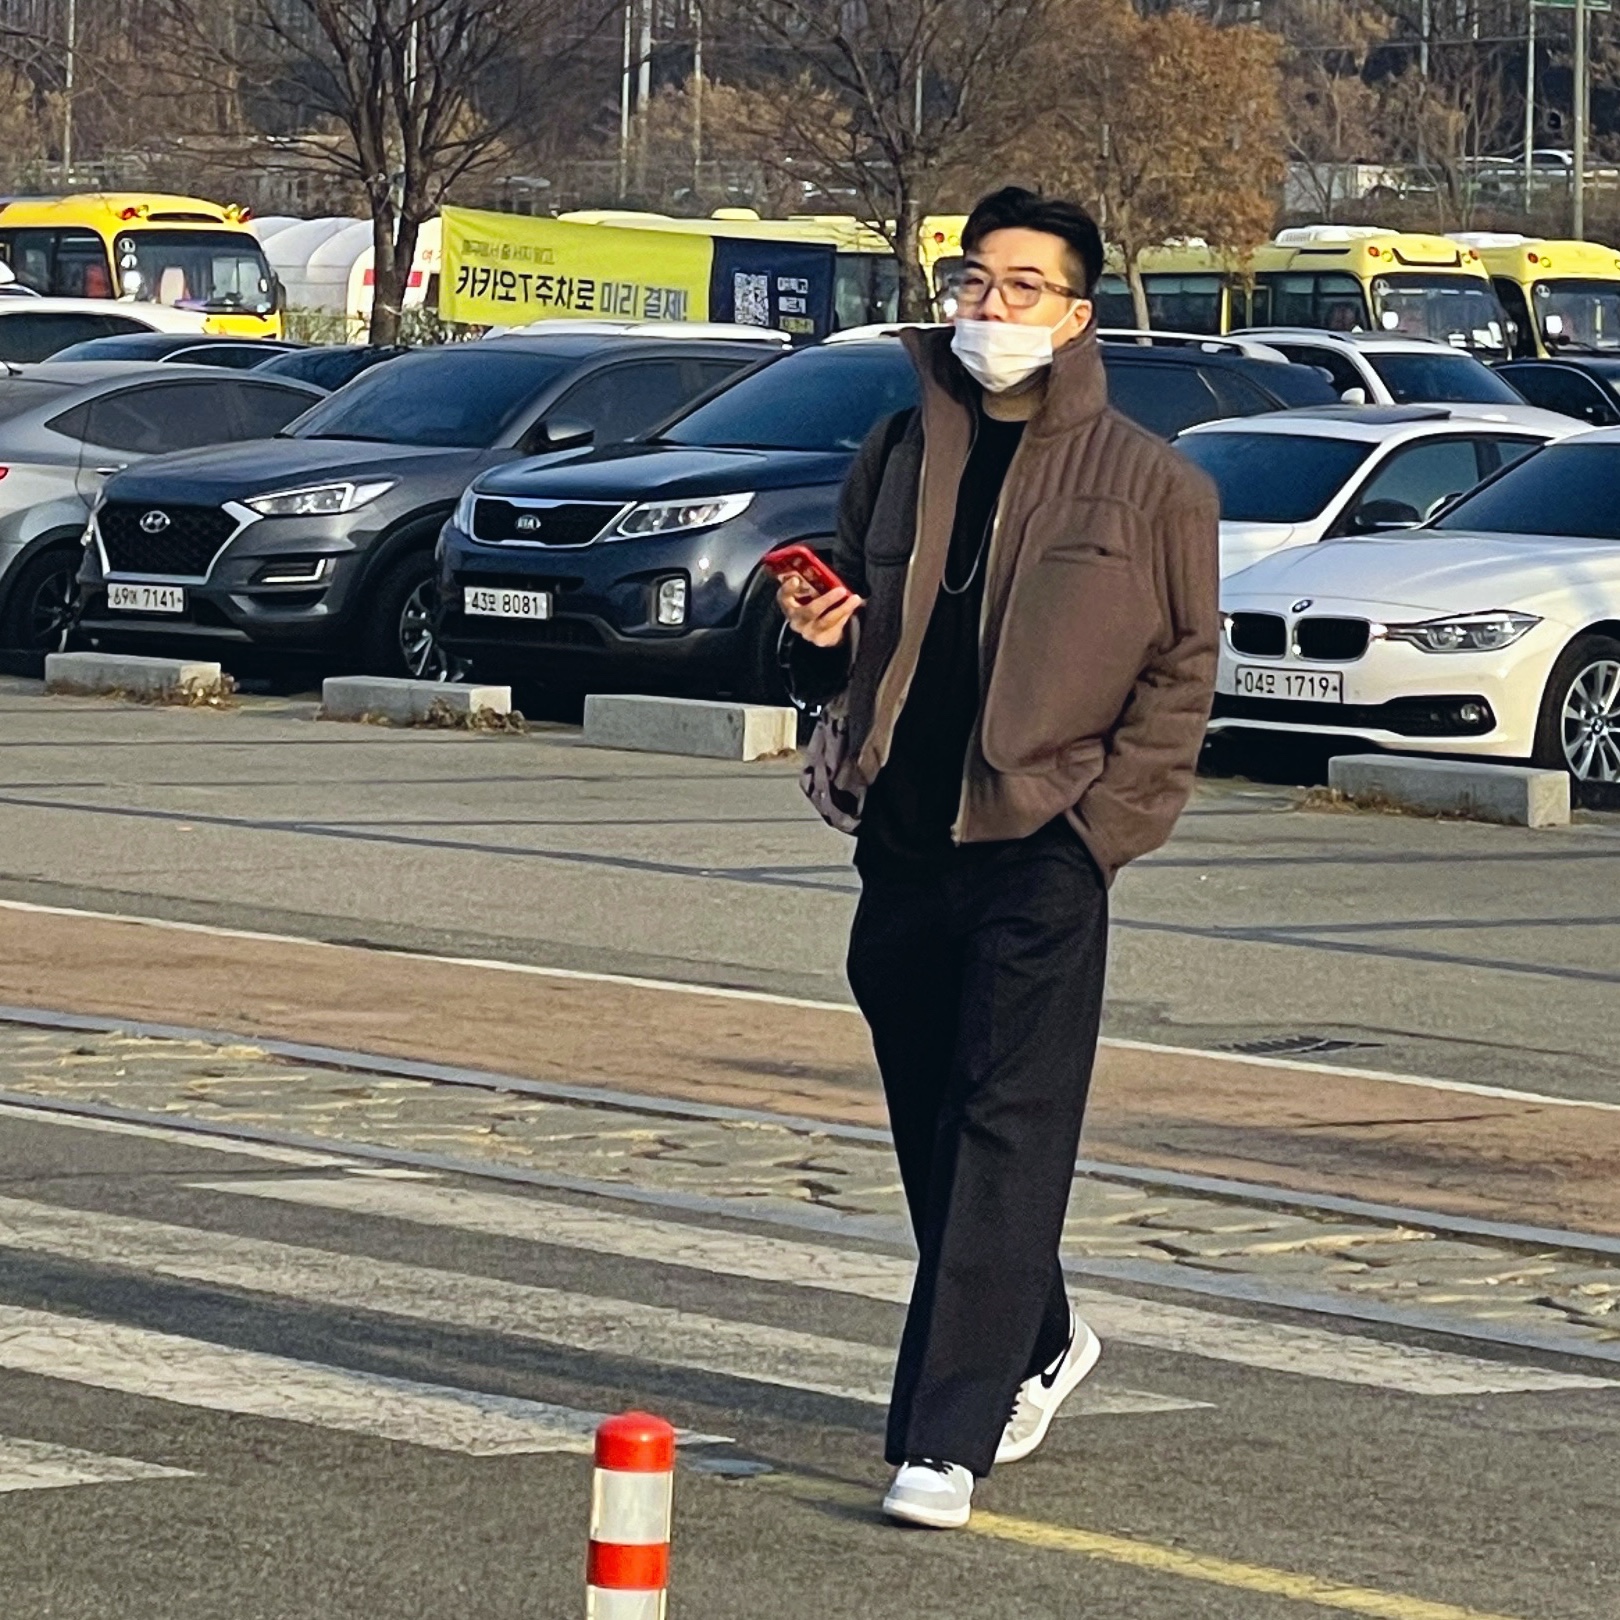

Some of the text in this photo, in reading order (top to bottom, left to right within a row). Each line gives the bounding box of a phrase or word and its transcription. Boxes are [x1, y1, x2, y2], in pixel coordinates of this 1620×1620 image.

[601, 282, 638, 316] 미리
[644, 287, 688, 320] 결제!
[143, 588, 175, 608] 7141
[503, 594, 538, 616] 8081
[1244, 671, 1329, 698] 04모 1719
